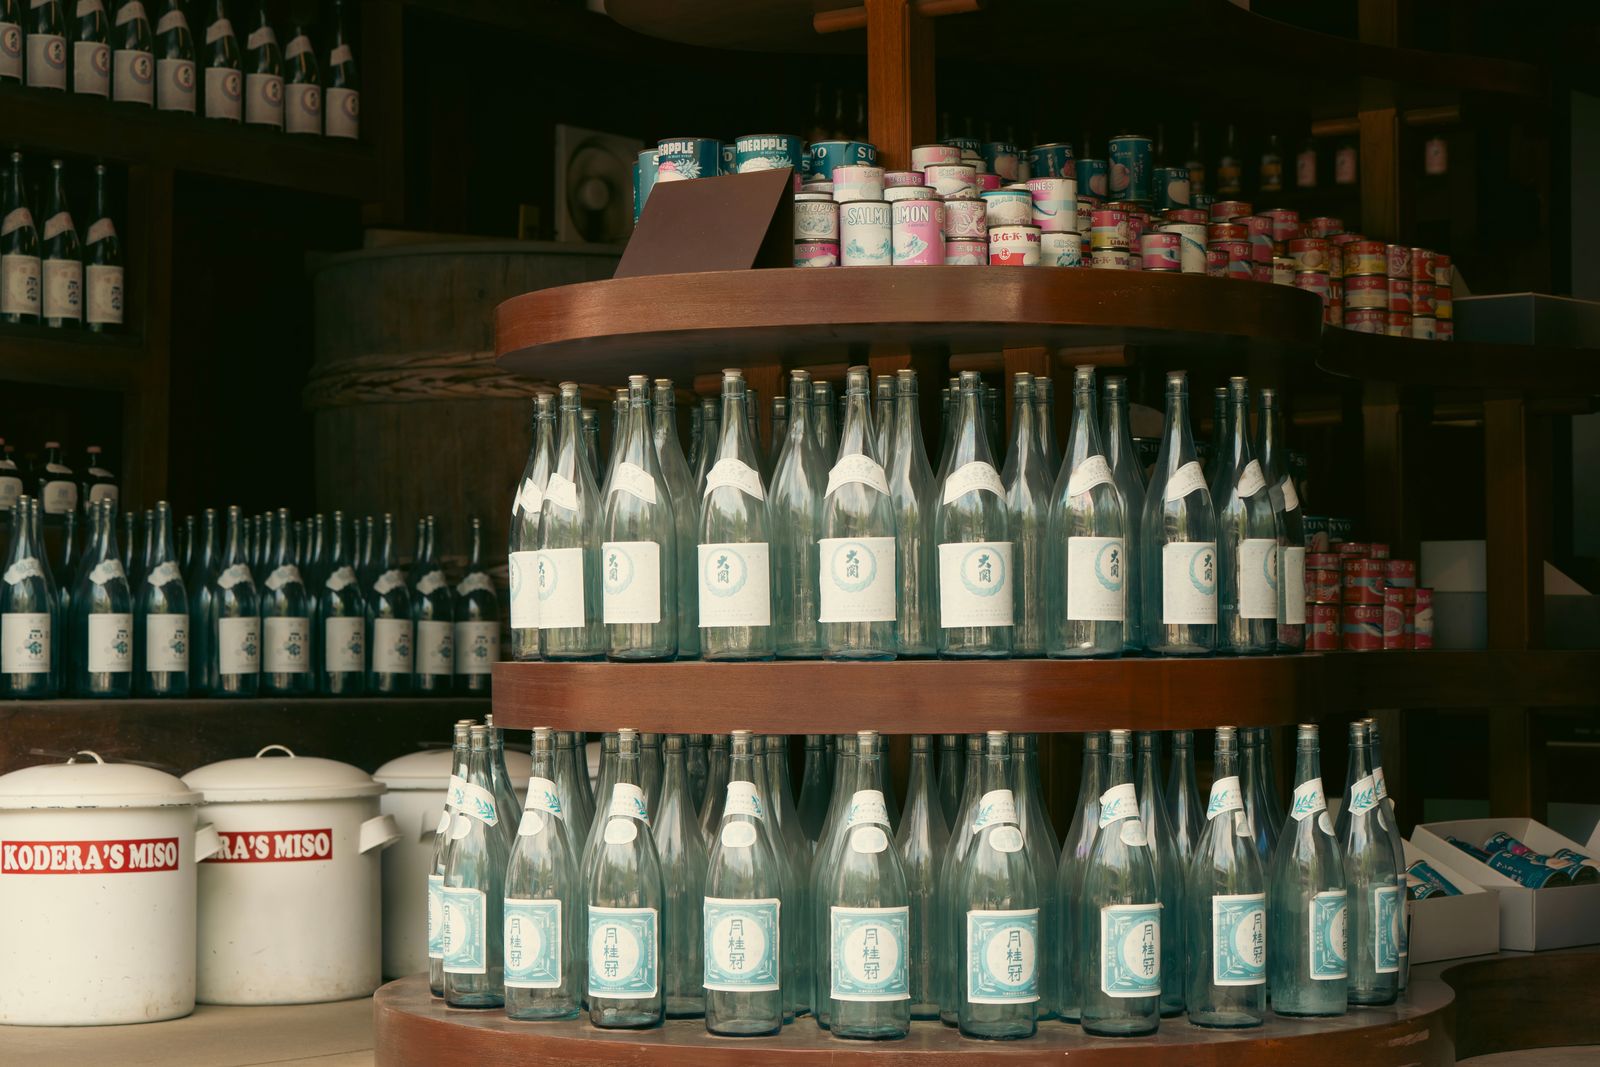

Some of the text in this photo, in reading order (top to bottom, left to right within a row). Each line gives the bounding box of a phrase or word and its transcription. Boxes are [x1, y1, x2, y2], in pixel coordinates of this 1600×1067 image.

[736, 138, 787, 153] PINEAPPLE
[3, 841, 178, 871] KODERA'S MISO
[207, 833, 330, 859] RA'S MISO
[510, 918, 522, 967] 月桂冠
[604, 927, 619, 977] 月桂冠
[728, 919, 745, 970] 月桂冠
[862, 927, 881, 980] 月桂冠
[1006, 930, 1023, 983] 月桂冠
[1142, 924, 1155, 976] 月桂冠
